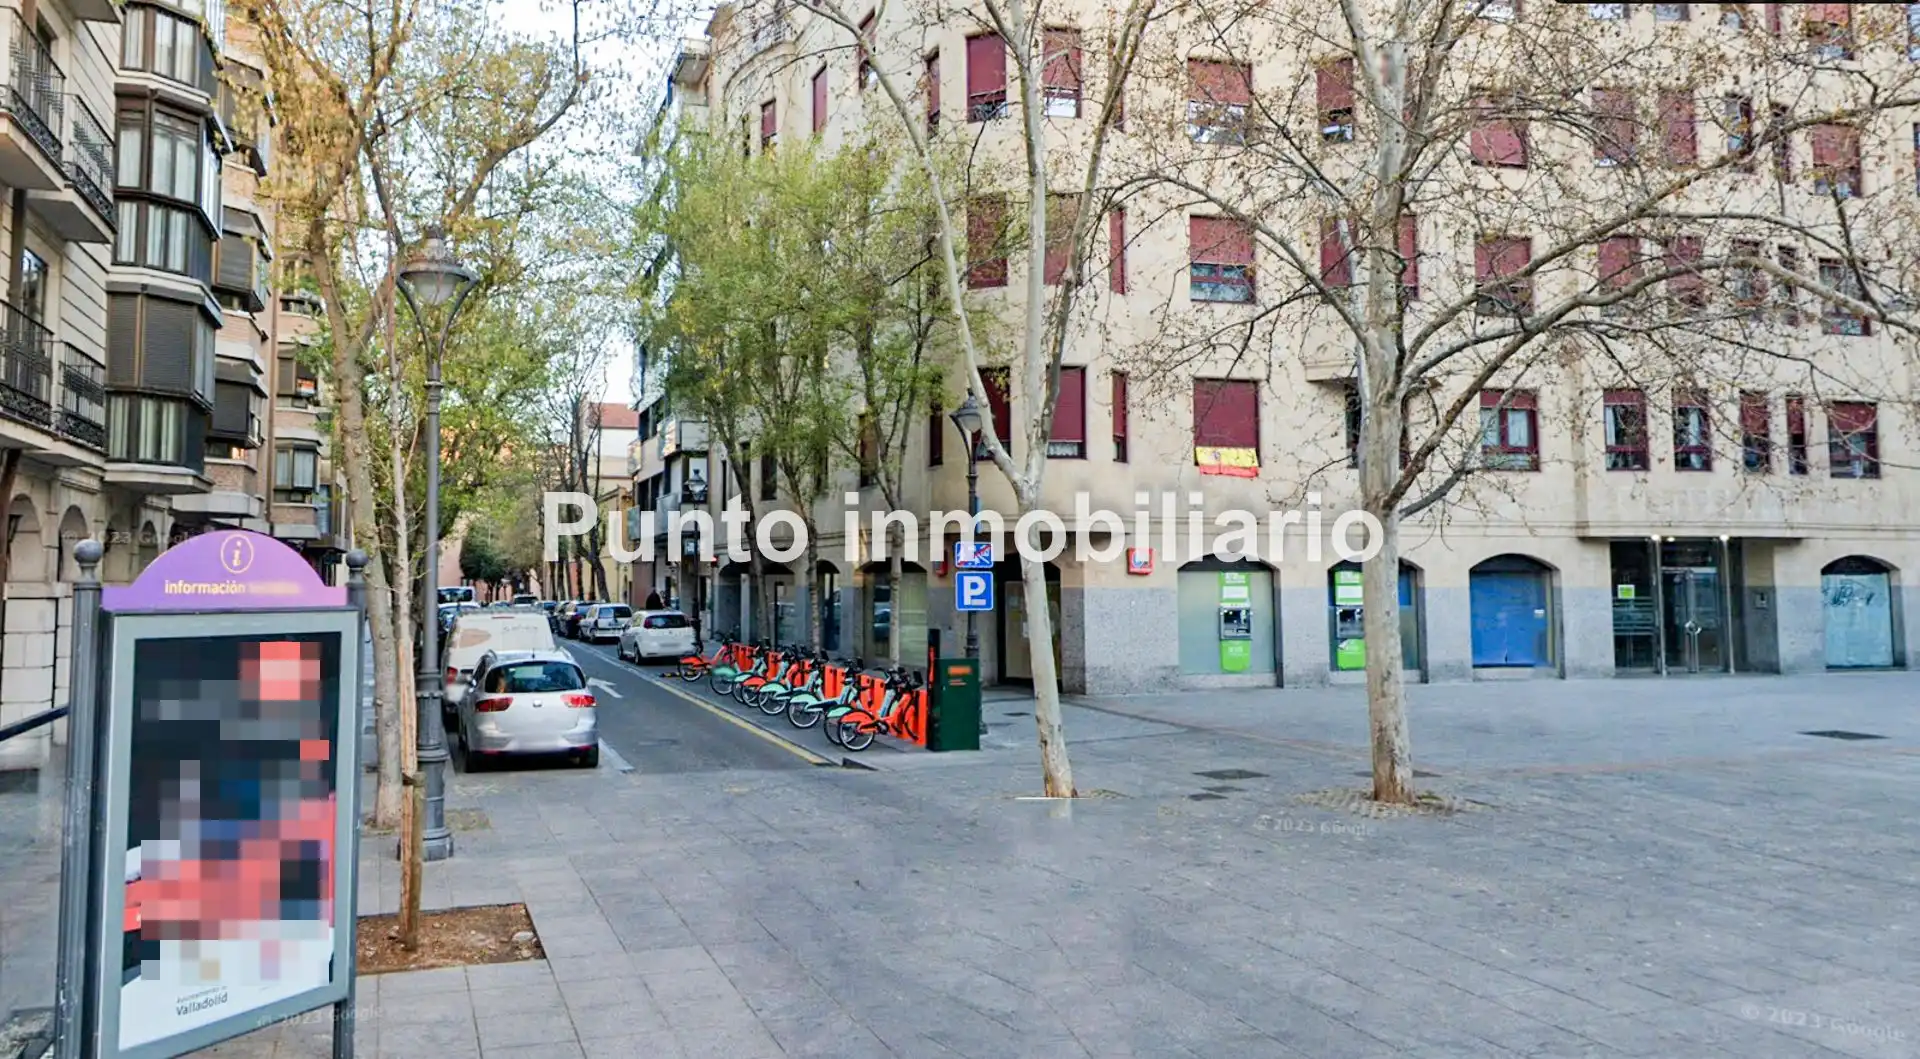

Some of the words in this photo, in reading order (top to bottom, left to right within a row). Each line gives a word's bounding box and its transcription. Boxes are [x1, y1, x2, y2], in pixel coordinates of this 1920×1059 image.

[164, 580, 245, 595] información
[963, 575, 987, 606] P
[176, 992, 228, 1015] Valladolid
